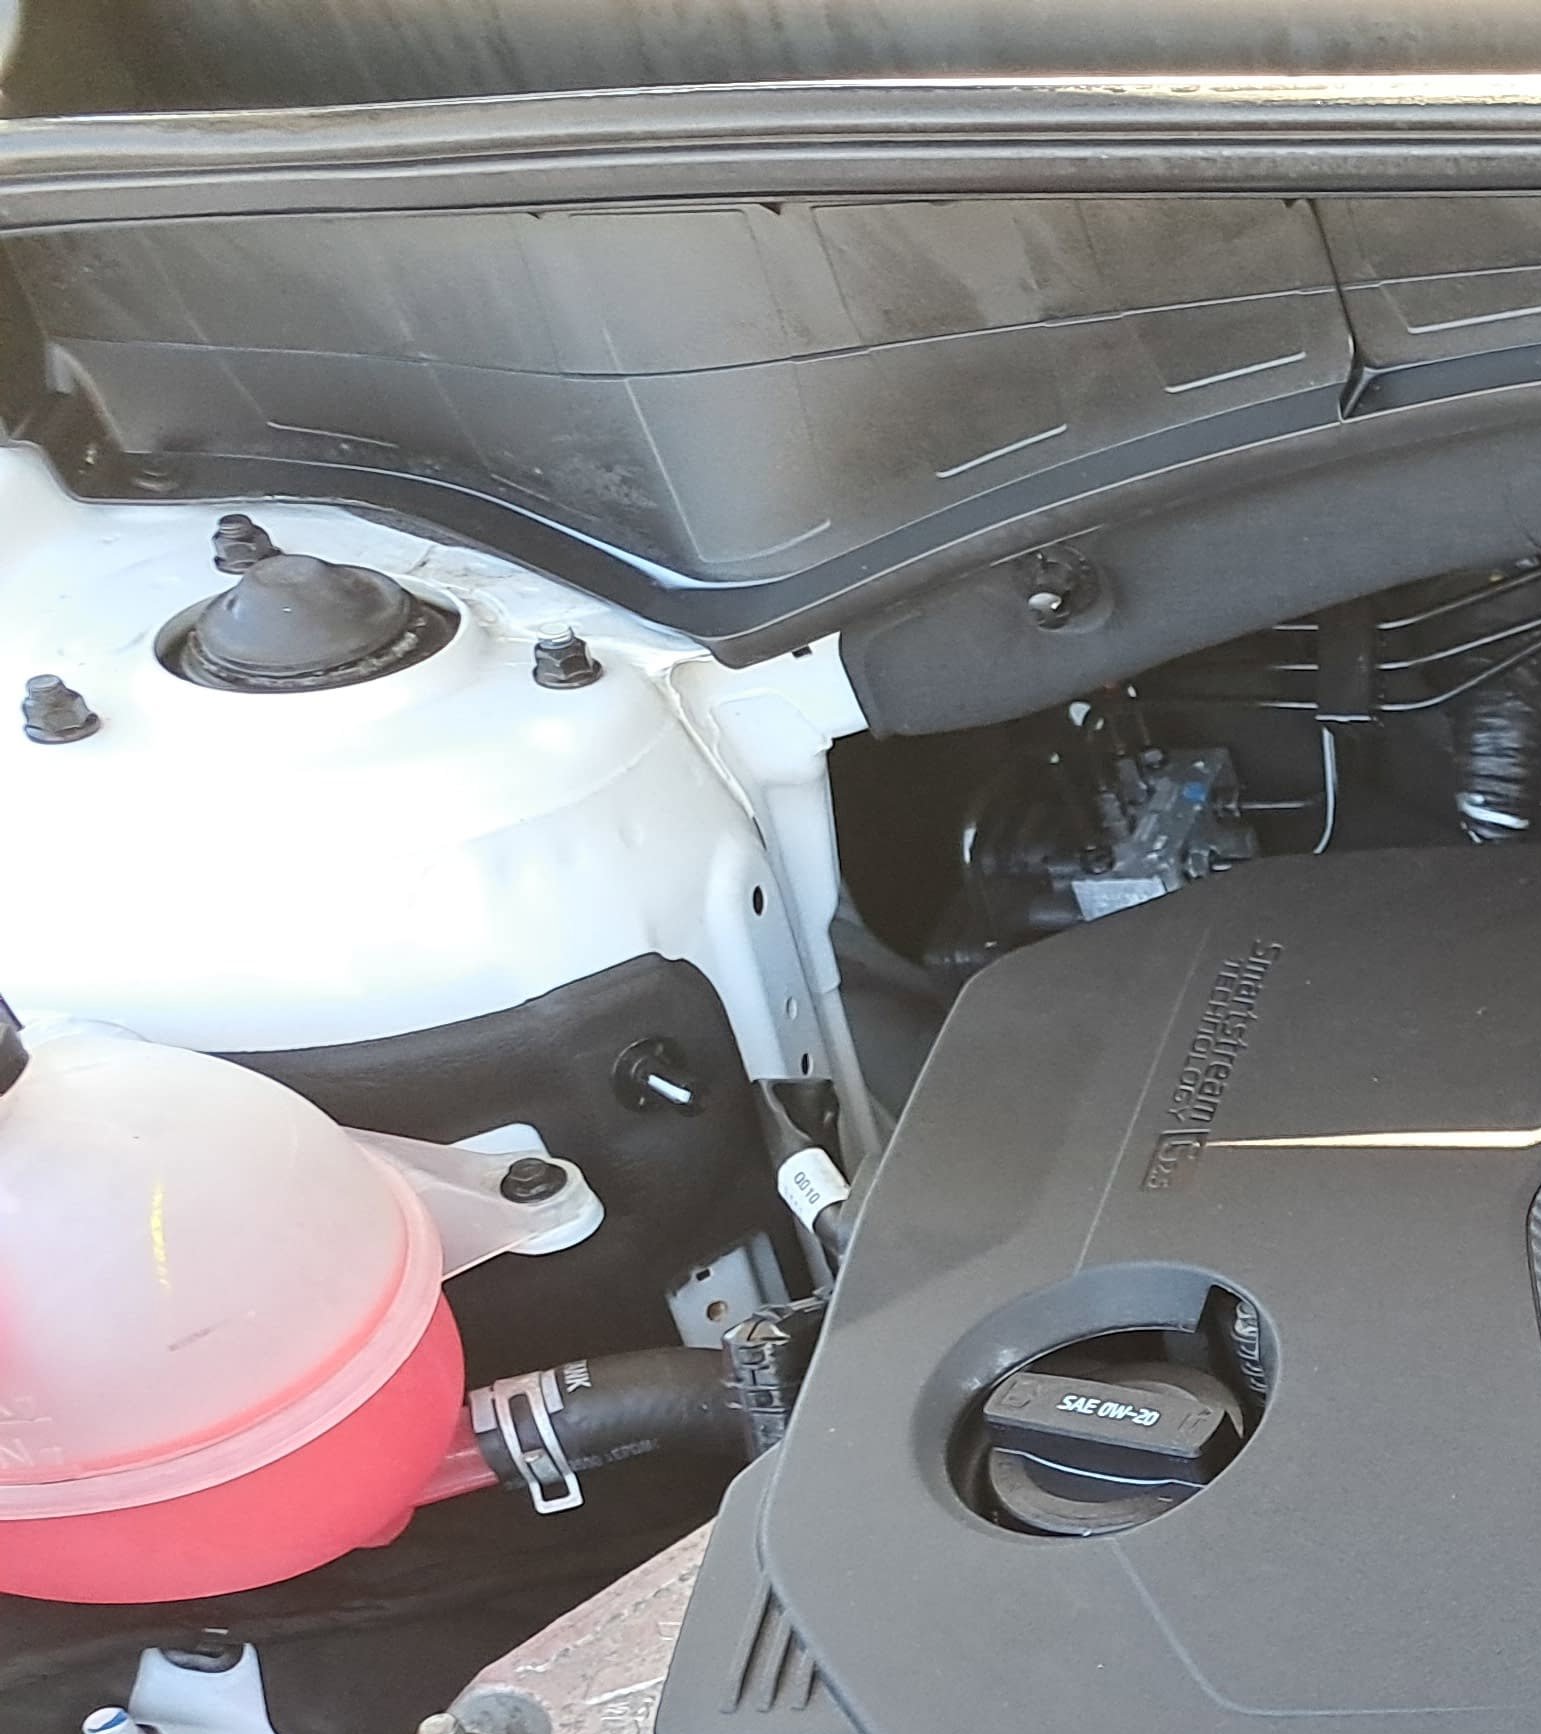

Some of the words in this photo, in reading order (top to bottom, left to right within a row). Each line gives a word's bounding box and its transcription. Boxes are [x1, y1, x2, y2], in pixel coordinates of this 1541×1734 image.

[1168, 959, 1243, 1122] TECHNOLOGY
[1191, 938, 1284, 1122] Smartstream
[1056, 1394, 1100, 1418] SAE
[1097, 1400, 1161, 1427] 0W-20
